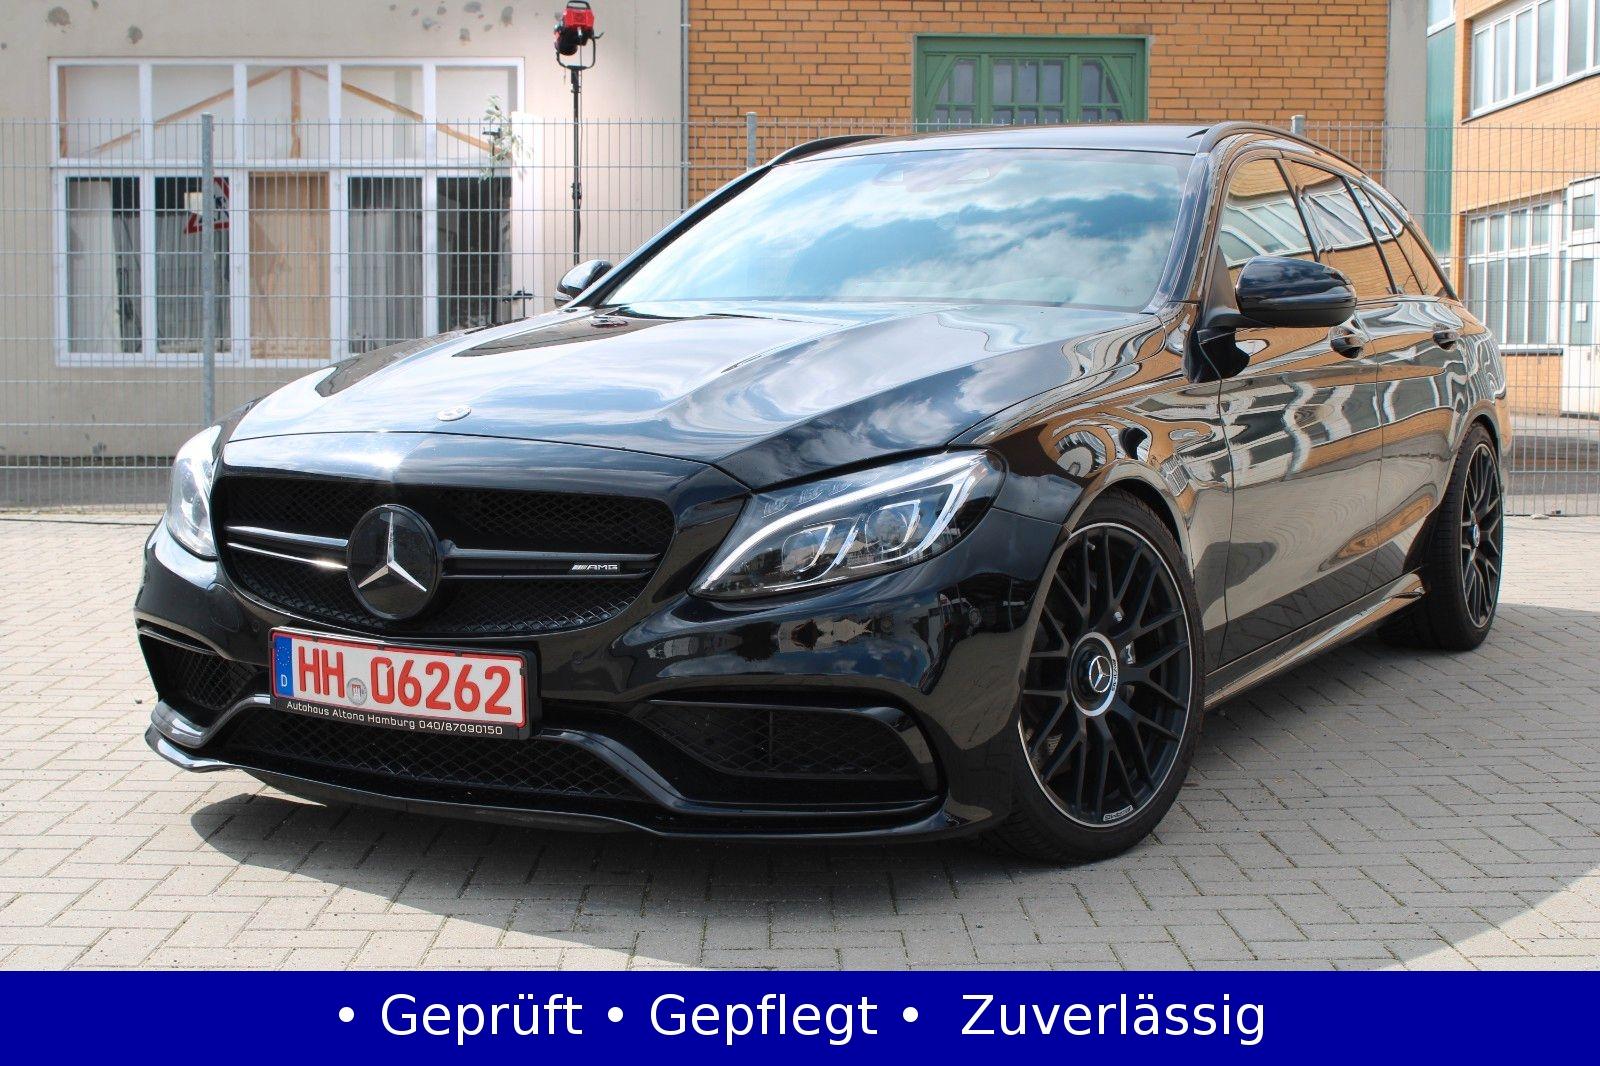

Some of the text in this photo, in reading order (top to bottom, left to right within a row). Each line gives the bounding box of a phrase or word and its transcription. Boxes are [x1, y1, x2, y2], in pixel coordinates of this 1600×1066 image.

[280, 674, 288, 688] D
[297, 646, 346, 698] HH
[370, 656, 512, 716] 06262
[286, 701, 503, 735] Autohaus Altona Hamburg 040/87090150
